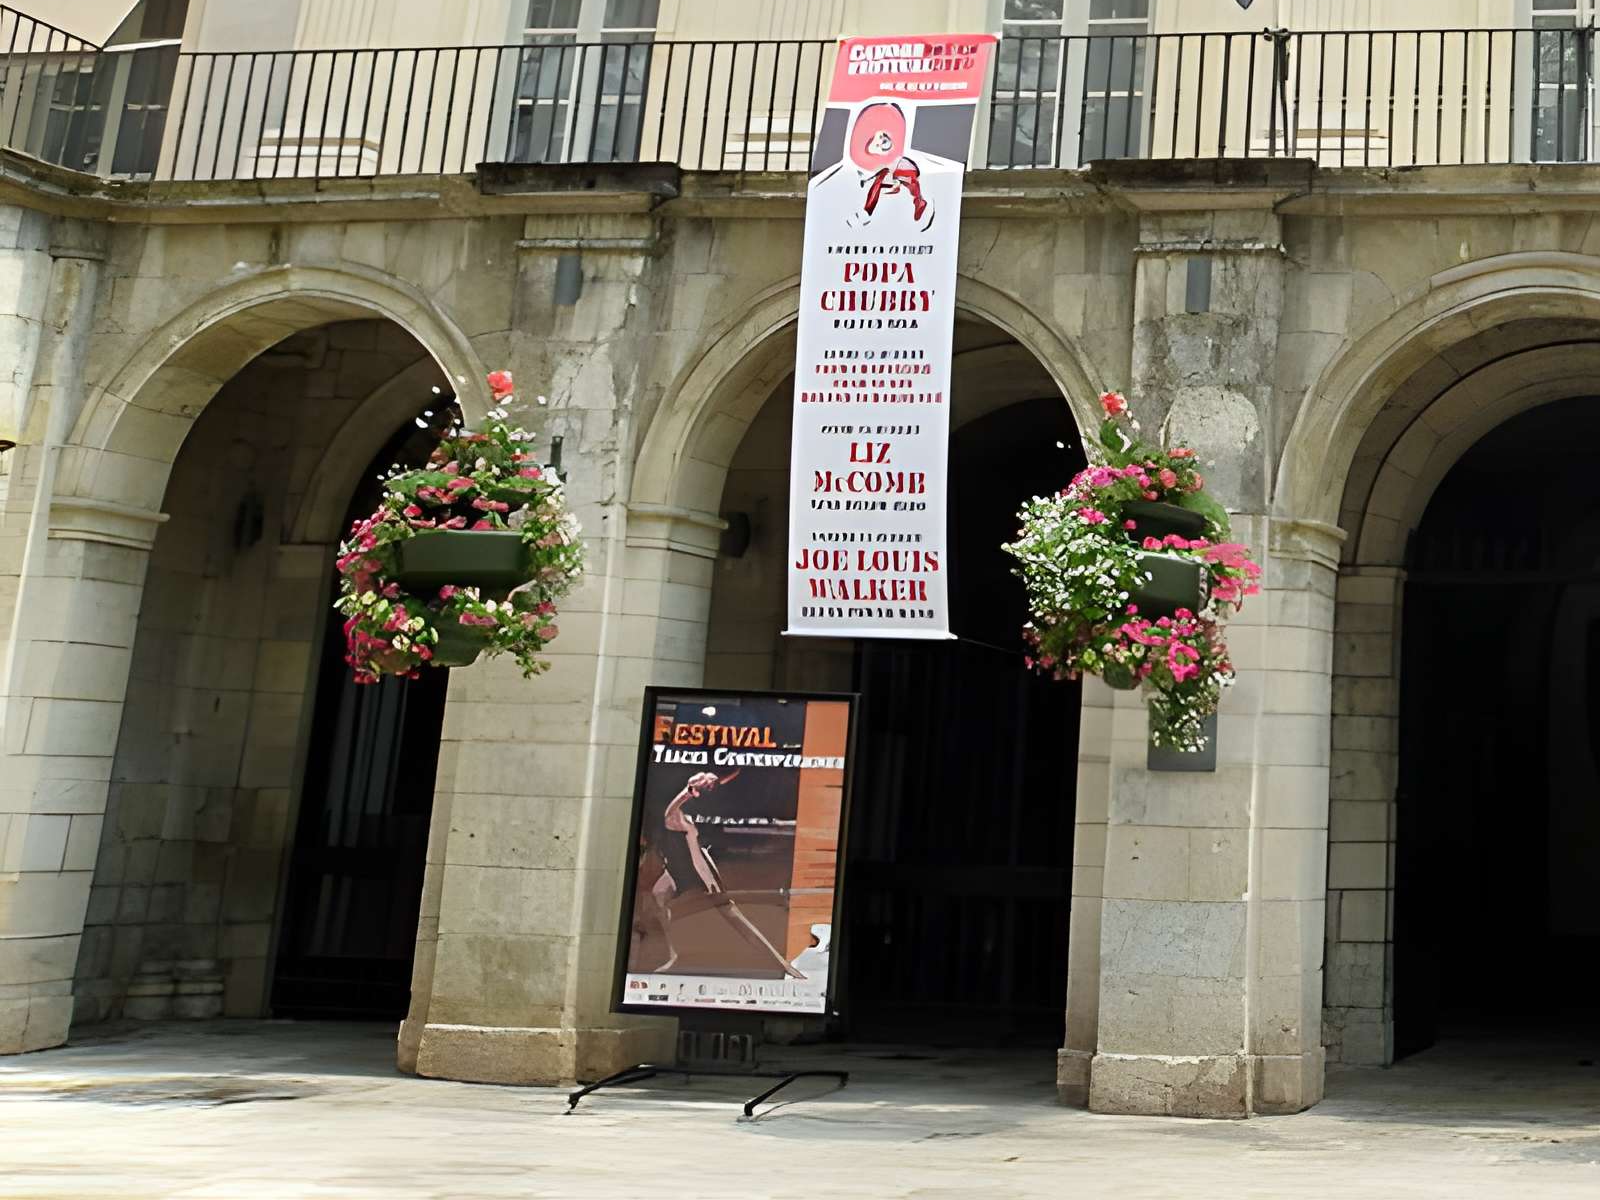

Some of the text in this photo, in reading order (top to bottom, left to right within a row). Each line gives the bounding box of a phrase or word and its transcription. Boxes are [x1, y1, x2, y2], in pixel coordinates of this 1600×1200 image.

[843, 262, 915, 284] POPA
[820, 289, 936, 312] CHUBBY
[849, 441, 891, 464] LIZ
[795, 548, 940, 573] JOE LOUIS
[808, 578, 928, 602] WALKER
